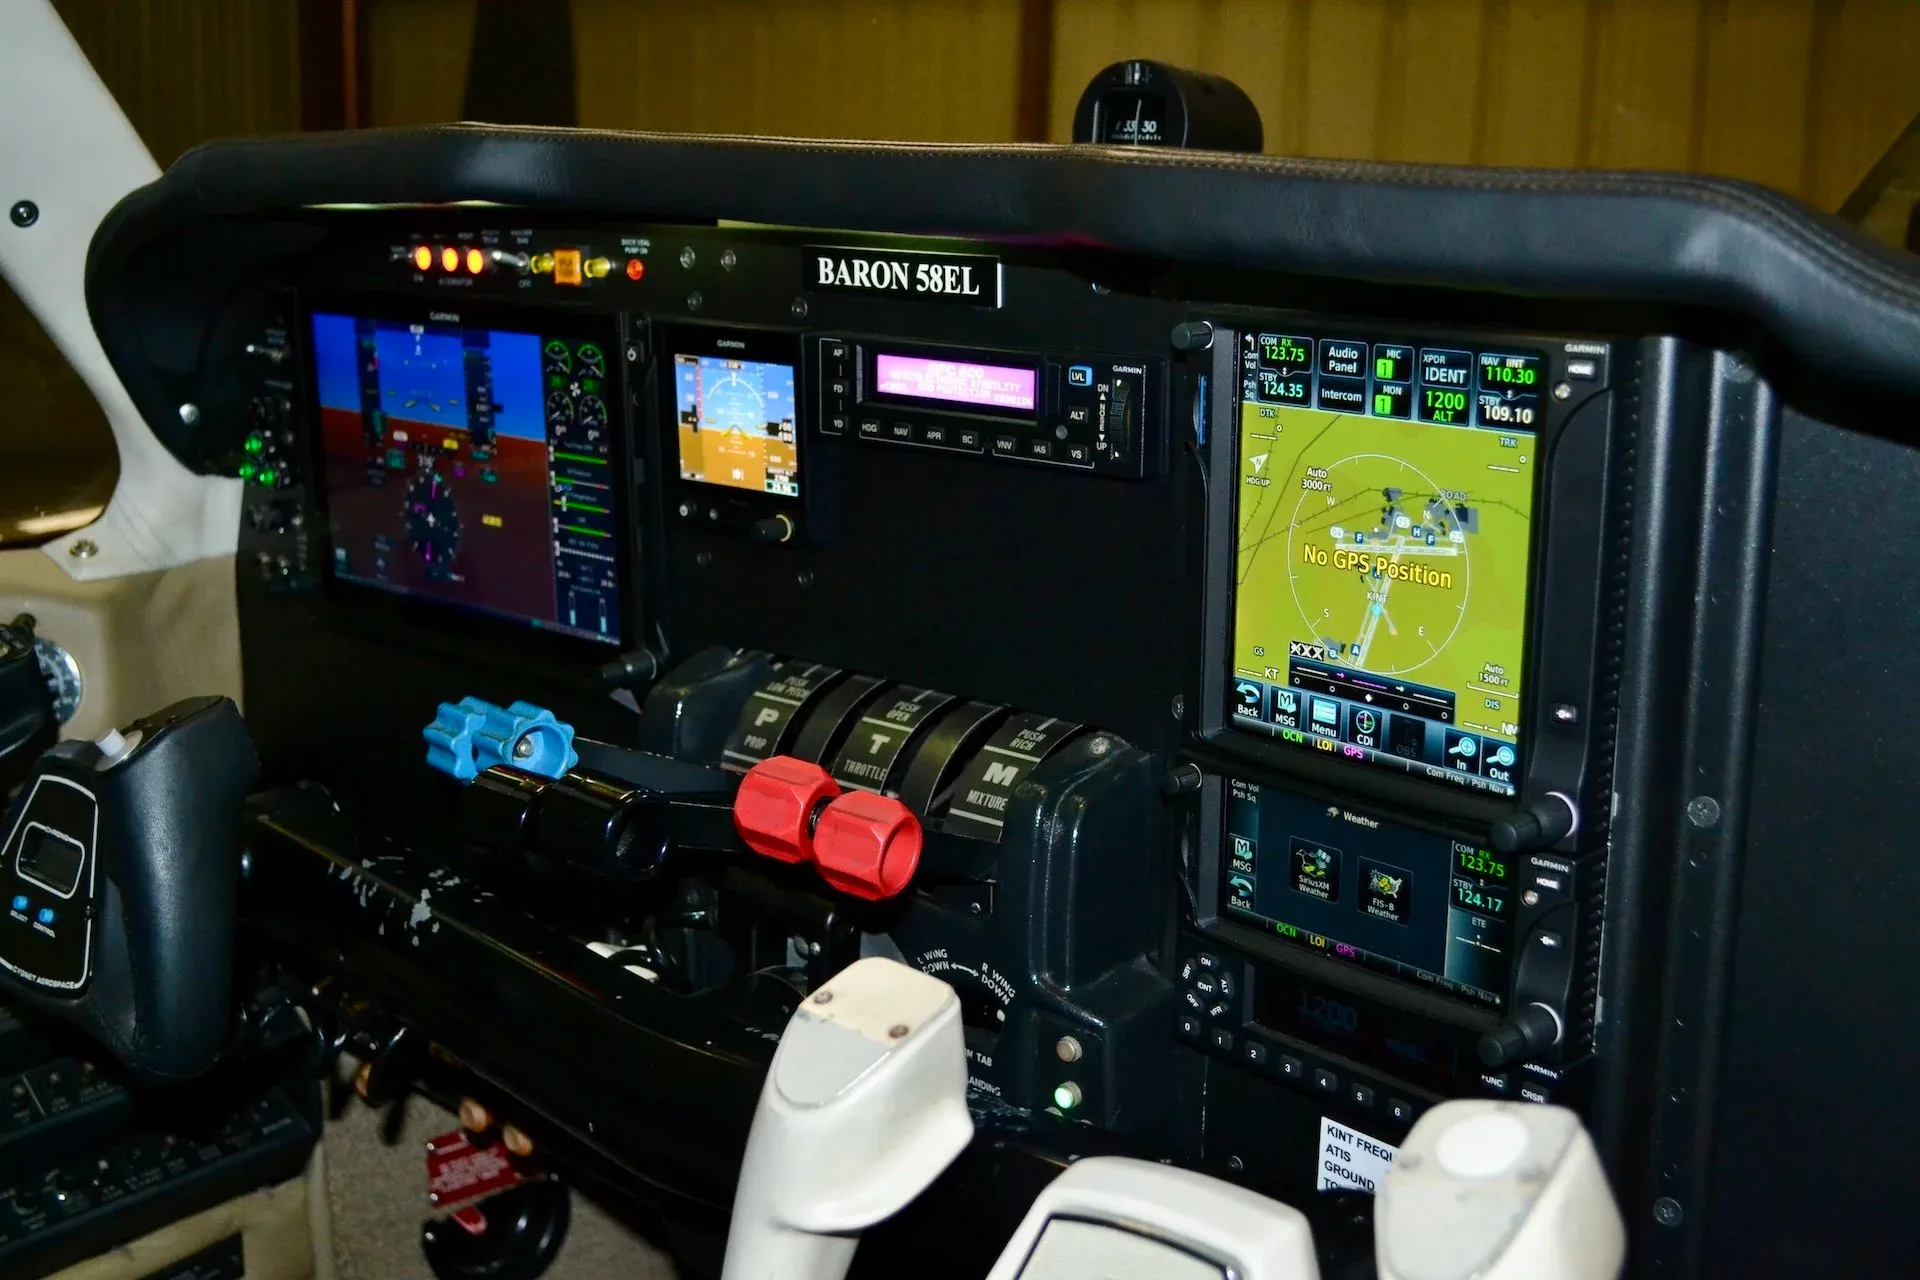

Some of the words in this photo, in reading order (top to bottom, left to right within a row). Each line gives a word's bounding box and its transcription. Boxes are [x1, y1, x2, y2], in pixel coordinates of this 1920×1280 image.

[1141, 120, 1157, 133] 30
[817, 257, 910, 290] BARON
[916, 263, 980, 295] 58EL
[717, 339, 745, 349] GARMIN
[1260, 336, 1277, 346] COM
[1281, 338, 1292, 347] RX
[833, 348, 843, 357] AP
[1265, 346, 1305, 362] 123.75
[1328, 346, 1358, 360] Audio
[1386, 349, 1402, 360] MIC
[1564, 343, 1605, 355] GARMIN
[1245, 361, 1256, 369] Vol
[1423, 354, 1446, 365] XPDR
[1481, 356, 1500, 366] NAV
[1112, 365, 1142, 374] GARMIN
[1328, 360, 1357, 374] Panel
[1071, 371, 1085, 381] LVL
[1259, 372, 1277, 382] STBY
[1425, 366, 1467, 384] IDENT
[1486, 366, 1535, 385] 110.30
[833, 384, 843, 393] FD
[1097, 383, 1109, 392] DN
[1243, 380, 1256, 389] Psh
[1264, 381, 1304, 398] 124.35
[1383, 385, 1402, 395] MON
[1245, 390, 1255, 400] Sq
[1321, 388, 1362, 403] Intercom
[1425, 390, 1465, 411] 1200
[1478, 395, 1501, 405] STBY
[1070, 411, 1084, 420] ALT
[1098, 403, 1106, 431] NOSE
[1259, 408, 1276, 418] DTK
[1433, 409, 1454, 422] ALT
[1484, 405, 1533, 424] 109.10
[862, 423, 877, 432] HDG
[893, 427, 908, 436] NAV
[926, 431, 942, 440] APR
[962, 435, 973, 444] BC
[997, 440, 1012, 450] VNV
[1096, 441, 1107, 450] UP
[1499, 437, 1517, 448] TRK
[1034, 445, 1046, 454] IAS
[1071, 449, 1082, 459] VS
[1306, 466, 1328, 479] Auto
[1246, 476, 1260, 486] HDG
[1261, 479, 1271, 487] UP
[1326, 496, 1336, 506] W
[1304, 544, 1328, 566] No
[1333, 549, 1370, 574] GPS
[1376, 557, 1452, 589] Position
[1366, 591, 1389, 604] KINT
[1323, 608, 1330, 618] S
[1418, 626, 1424, 636] E
[1253, 646, 1264, 656] GS
[1264, 667, 1279, 680] KT
[1484, 662, 1504, 675] Auto
[893, 701, 921, 713] PUSH
[1237, 703, 1258, 717] Back
[1484, 698, 1501, 710] DIS
[754, 707, 780, 727] P
[886, 709, 911, 722] OPEN
[1275, 713, 1296, 727] MSG
[1018, 729, 1046, 742] PUSH
[1282, 729, 1303, 744] OCN
[1311, 722, 1337, 738] Menu
[744, 735, 767, 750] PROP
[870, 734, 891, 755] T
[1009, 739, 1036, 751] RICH
[1316, 738, 1333, 751] LOI
[1356, 734, 1374, 746] CDI
[1343, 745, 1364, 759] GPS
[844, 759, 887, 781] THROTTLE
[1456, 759, 1467, 771] In
[982, 762, 1019, 787] M
[1425, 767, 1444, 778] Com
[1446, 771, 1465, 785] Freq
[1471, 778, 1486, 790] Psh
[1489, 783, 1505, 794] Nav
[1489, 767, 1510, 782] Out
[1231, 779, 1246, 790] Com
[1248, 782, 1259, 793] Vol
[966, 789, 1008, 812] MIXTURE
[1232, 788, 1245, 799] Psh
[1247, 793, 1257, 803] Sq
[1343, 811, 1379, 829] Weather
[1455, 843, 1474, 856] COM
[1479, 850, 1491, 860] RX
[1232, 859, 1252, 873] MSG
[1460, 854, 1505, 878] 123.75
[1530, 857, 1570, 873] GARMIN
[1298, 874, 1330, 891] SiriusXM
[1453, 878, 1473, 891] STBY
[1536, 877, 1559, 890] HOME
[1298, 883, 1329, 899] Weather
[1231, 895, 1251, 910] Back
[1372, 897, 1394, 912] FIS-B
[1458, 888, 1502, 912] 124.17
[1367, 905, 1399, 922] Weather
[1471, 916, 1487, 928] ETE
[1276, 923, 1297, 937] OCN
[1310, 934, 1326, 948] LOI
[923, 948, 948, 961] WING
[1336, 943, 1356, 957] GPS
[922, 961, 950, 974] DOWN
[1200, 957, 1212, 967] ON
[36, 976, 75, 990] AEROSPACE
[982, 962, 988, 973] R
[991, 969, 1016, 998] WING
[1220, 979, 1229, 994] ALT
[1416, 970, 1434, 982] Com
[1436, 976, 1454, 991] Freq
[981, 974, 1010, 1005] DOWN
[1197, 981, 1213, 993] IDNT
[1186, 993, 1199, 1008] OFF
[1210, 1005, 1223, 1016] VFR
[976, 1052, 992, 1067] TAB
[968, 1075, 1001, 1097] ANDING
[1521, 1088, 1544, 1103] CRSR
[1327, 1124, 1354, 1145] KINT
[1325, 1143, 1351, 1162] ATIS
[1324, 1160, 1375, 1191] GROUND
[1323, 1177, 1343, 1190] TO
